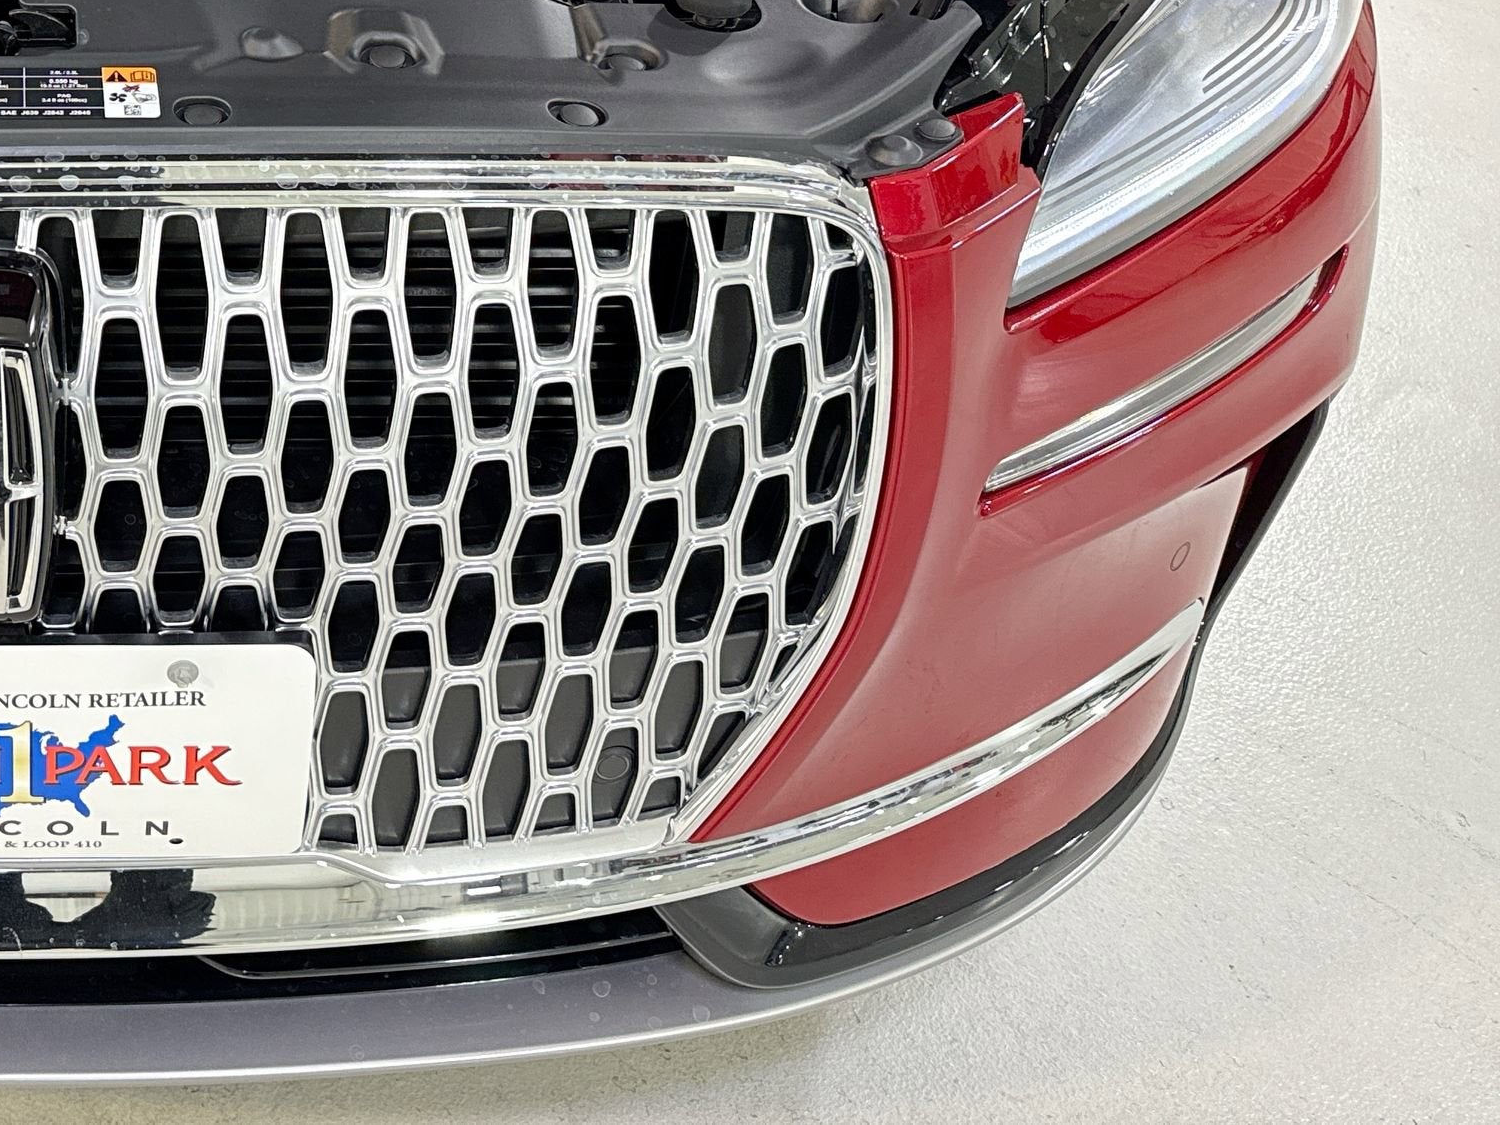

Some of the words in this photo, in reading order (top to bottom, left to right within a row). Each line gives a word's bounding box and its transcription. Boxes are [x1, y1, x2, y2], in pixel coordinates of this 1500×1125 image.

[88, 690, 207, 709] RETAILER
[44, 745, 243, 786] PARK
[3, 839, 16, 849] &
[22, 839, 68, 849] LOOP
[72, 839, 103, 849] 410
